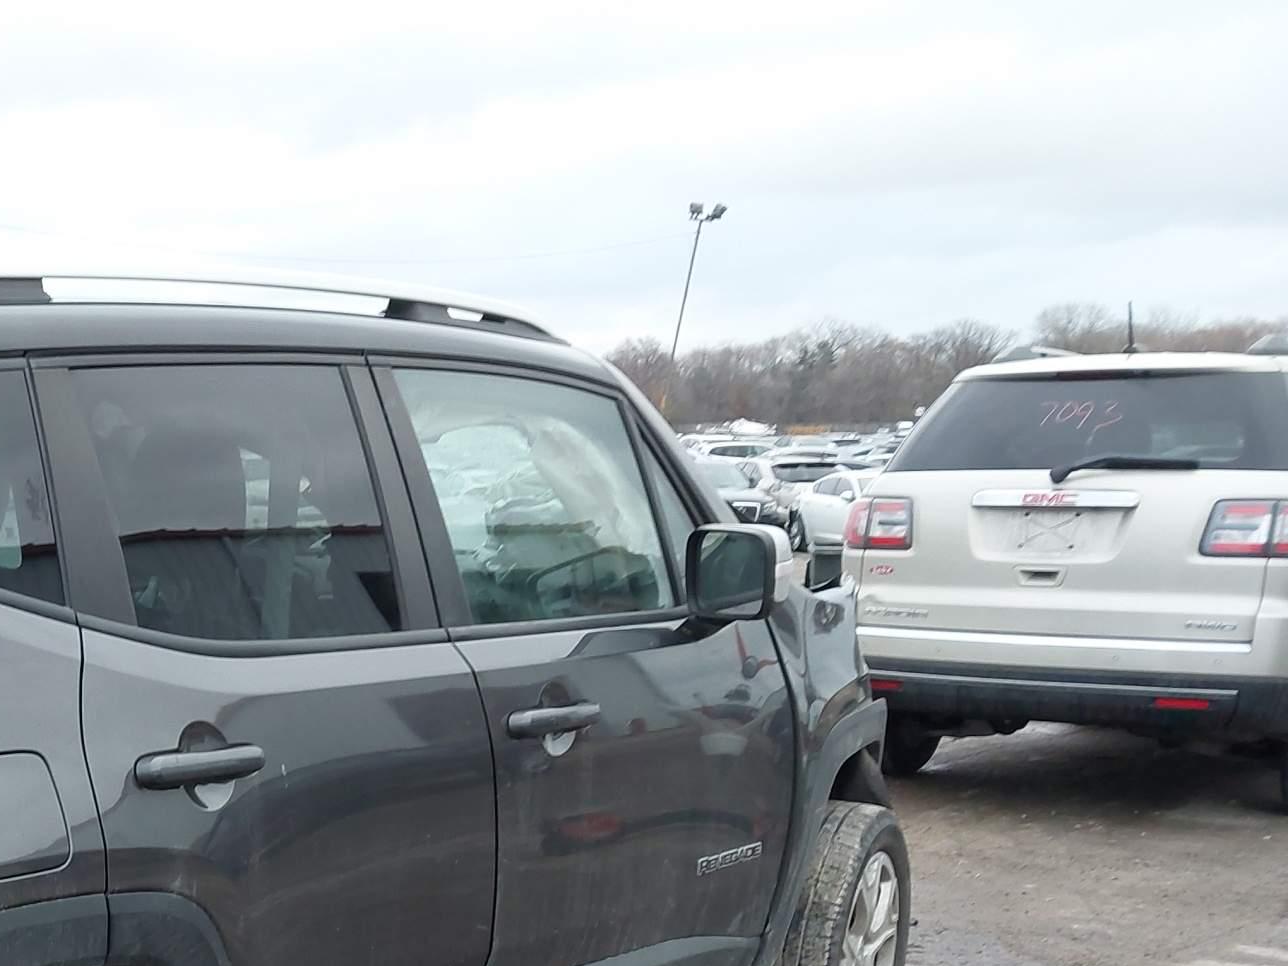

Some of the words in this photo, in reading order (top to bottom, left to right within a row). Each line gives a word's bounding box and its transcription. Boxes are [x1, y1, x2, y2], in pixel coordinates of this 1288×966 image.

[1040, 399, 1123, 434] 7093
[1021, 493, 1079, 506] GMC
[697, 840, 762, 877] RENEGADE
